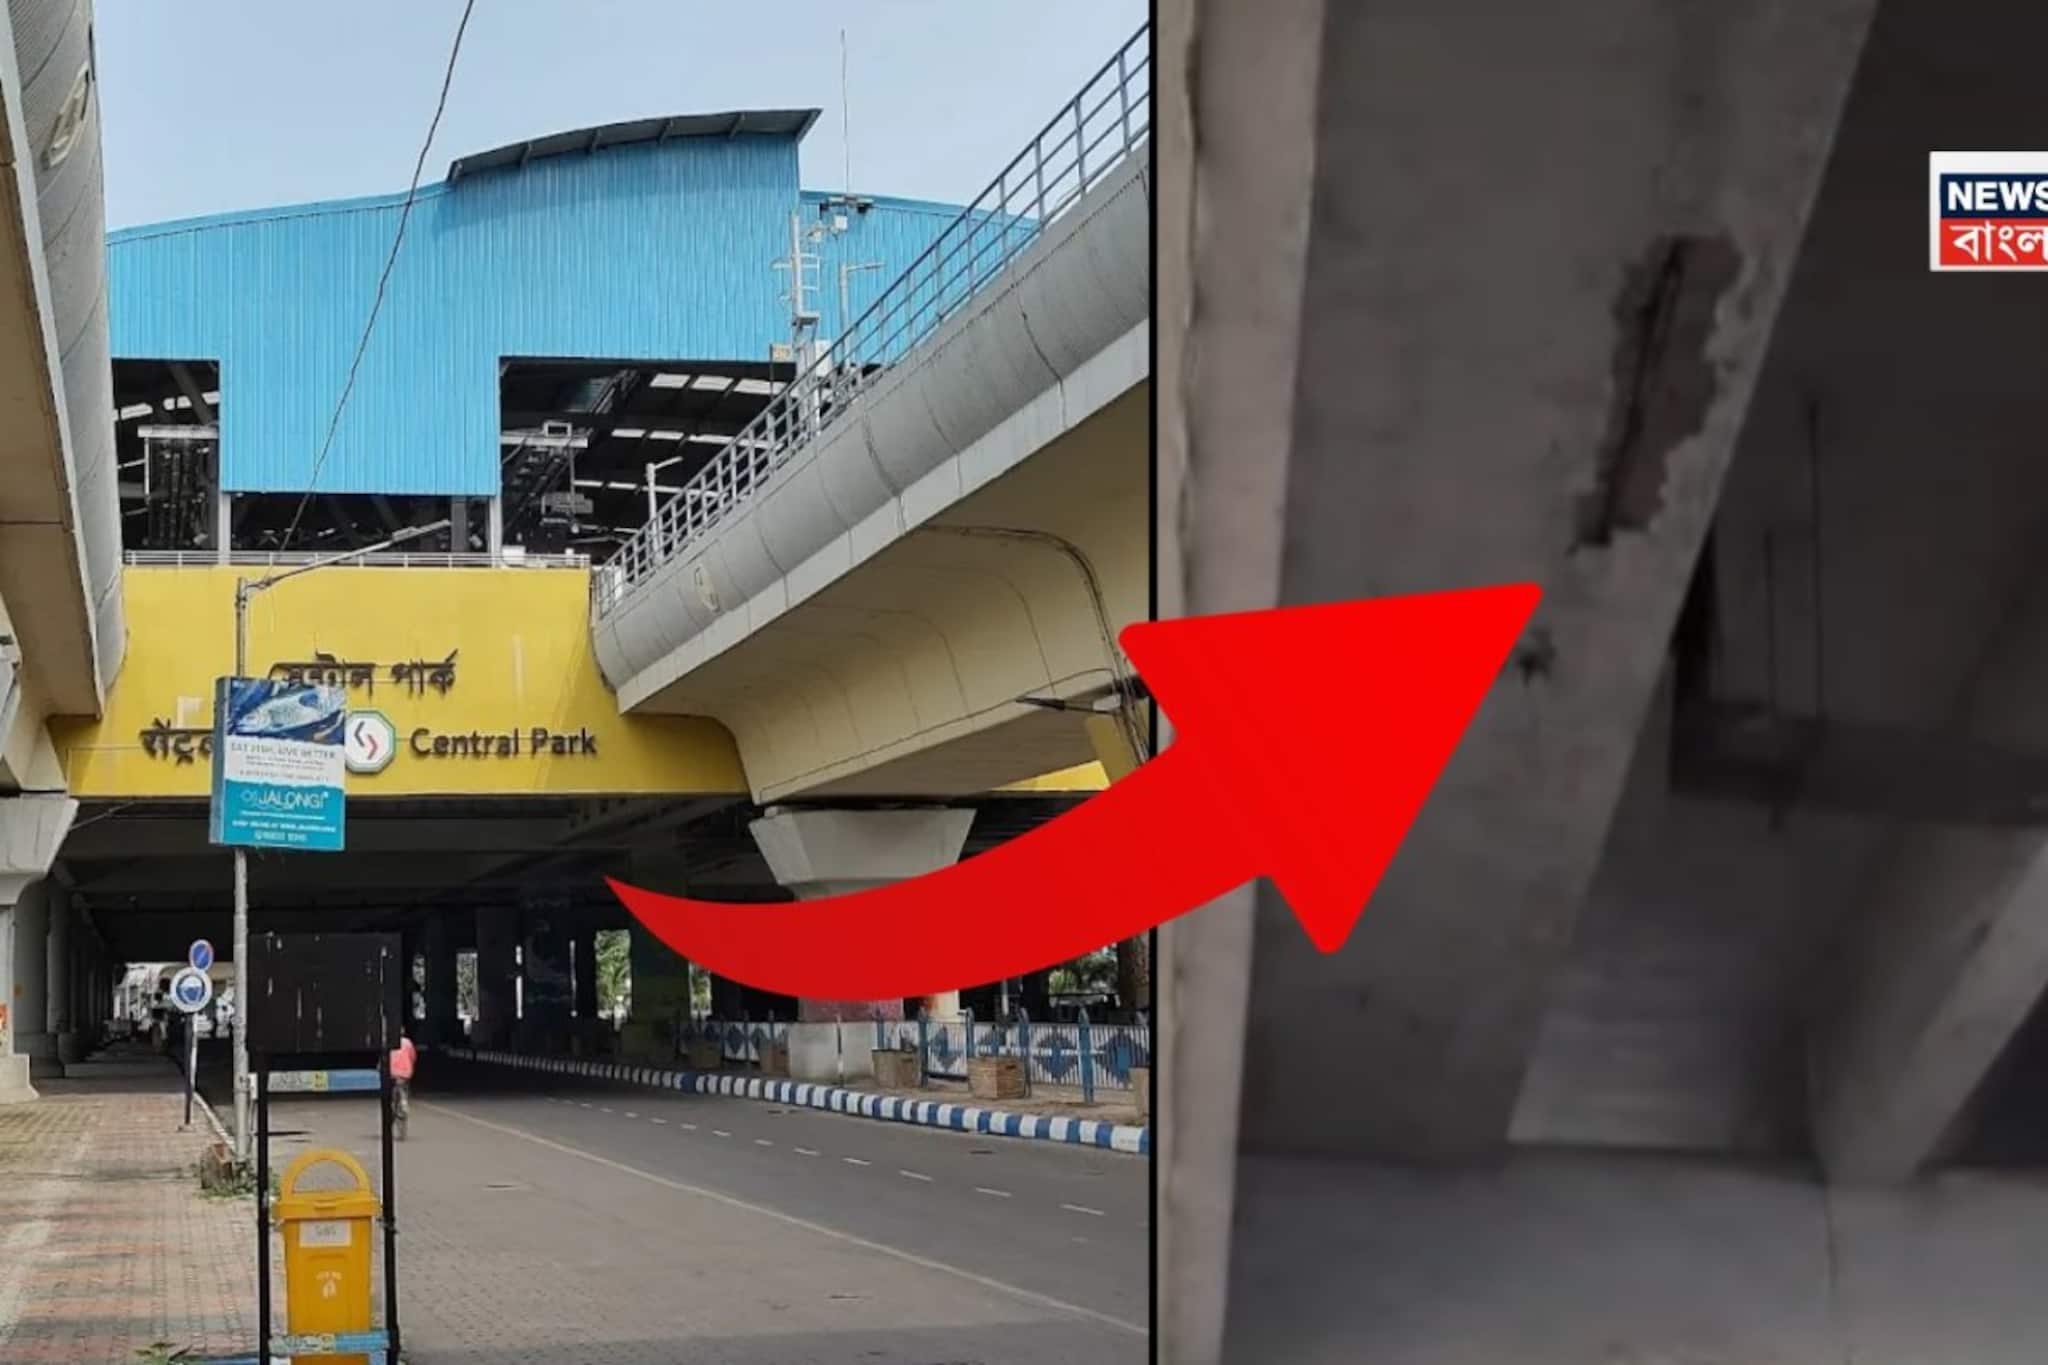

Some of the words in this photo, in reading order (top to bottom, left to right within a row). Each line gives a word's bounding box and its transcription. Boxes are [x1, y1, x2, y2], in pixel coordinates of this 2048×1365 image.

[391, 648, 458, 698] পার্ক
[409, 727, 519, 758] Central
[530, 727, 597, 757] Park
[259, 788, 325, 809] JALONGI
